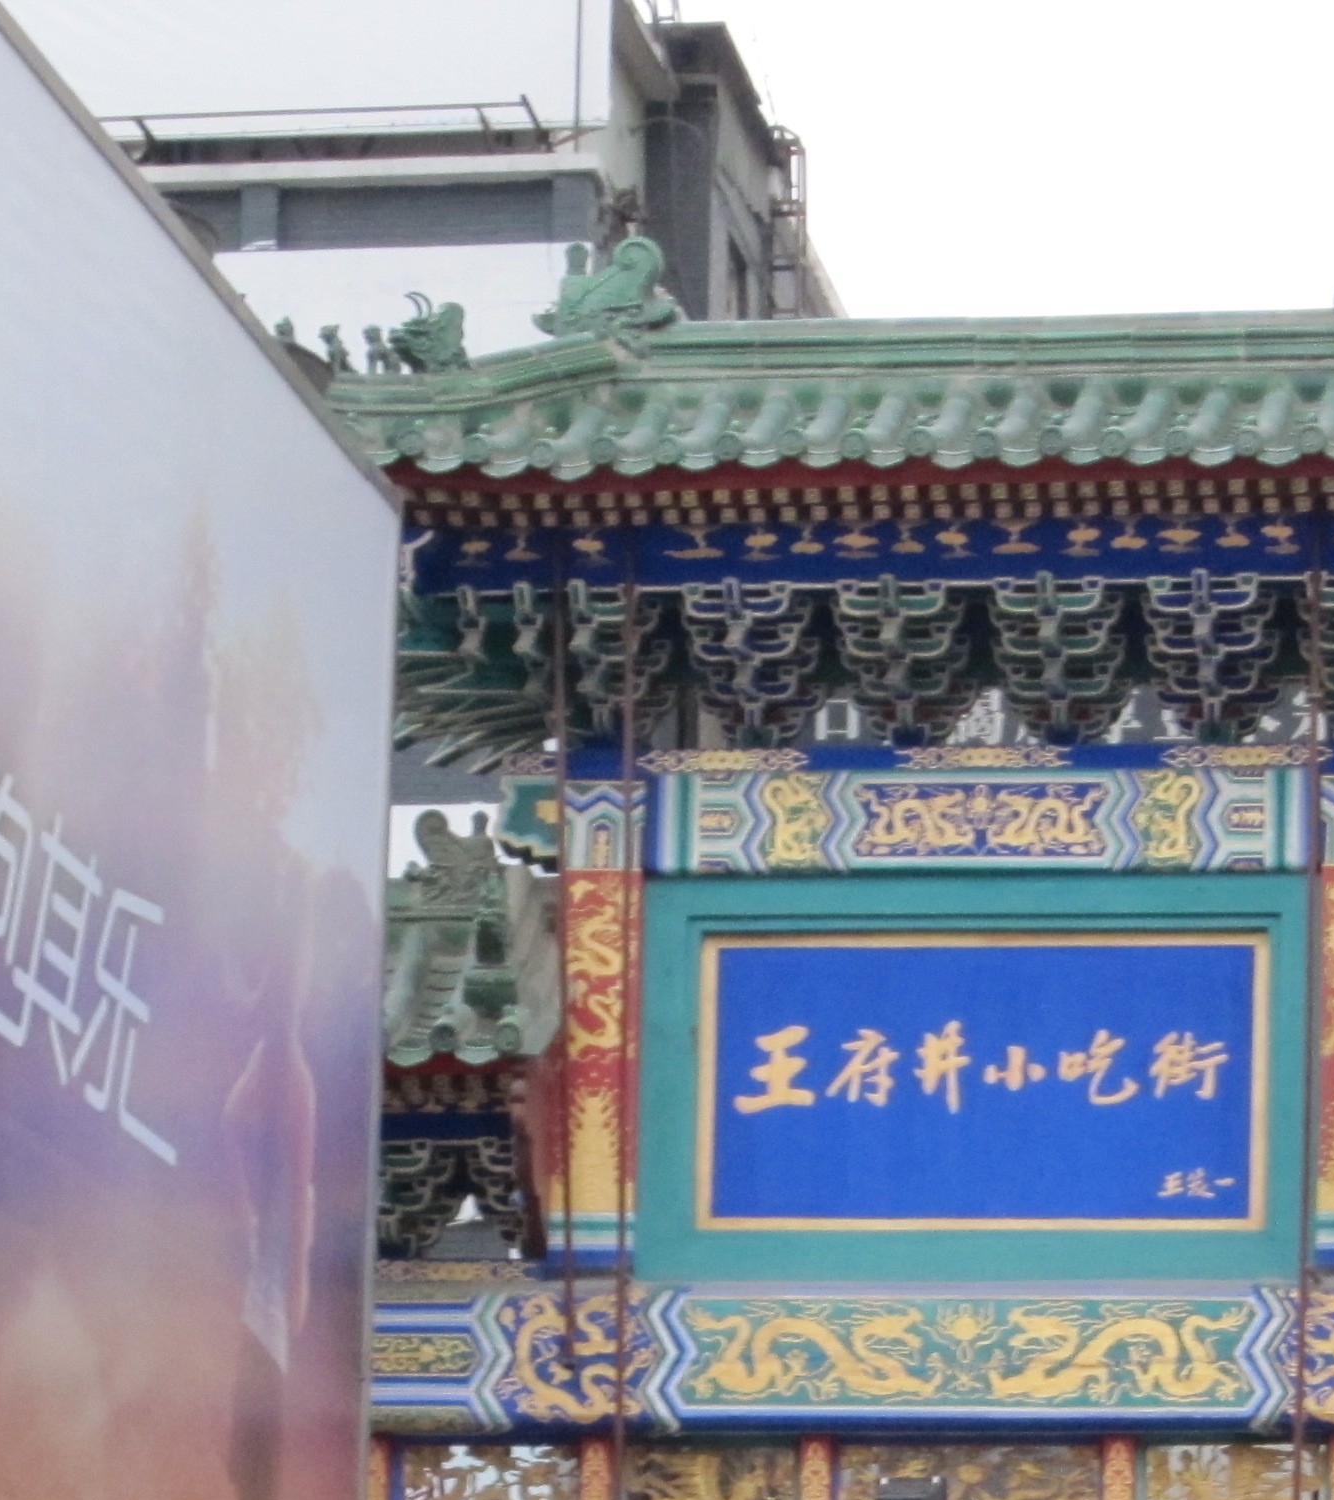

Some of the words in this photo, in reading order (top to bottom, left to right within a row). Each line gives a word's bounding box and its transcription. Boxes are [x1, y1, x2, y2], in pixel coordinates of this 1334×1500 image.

[733, 1019, 1232, 1115] 王府井小吃街
